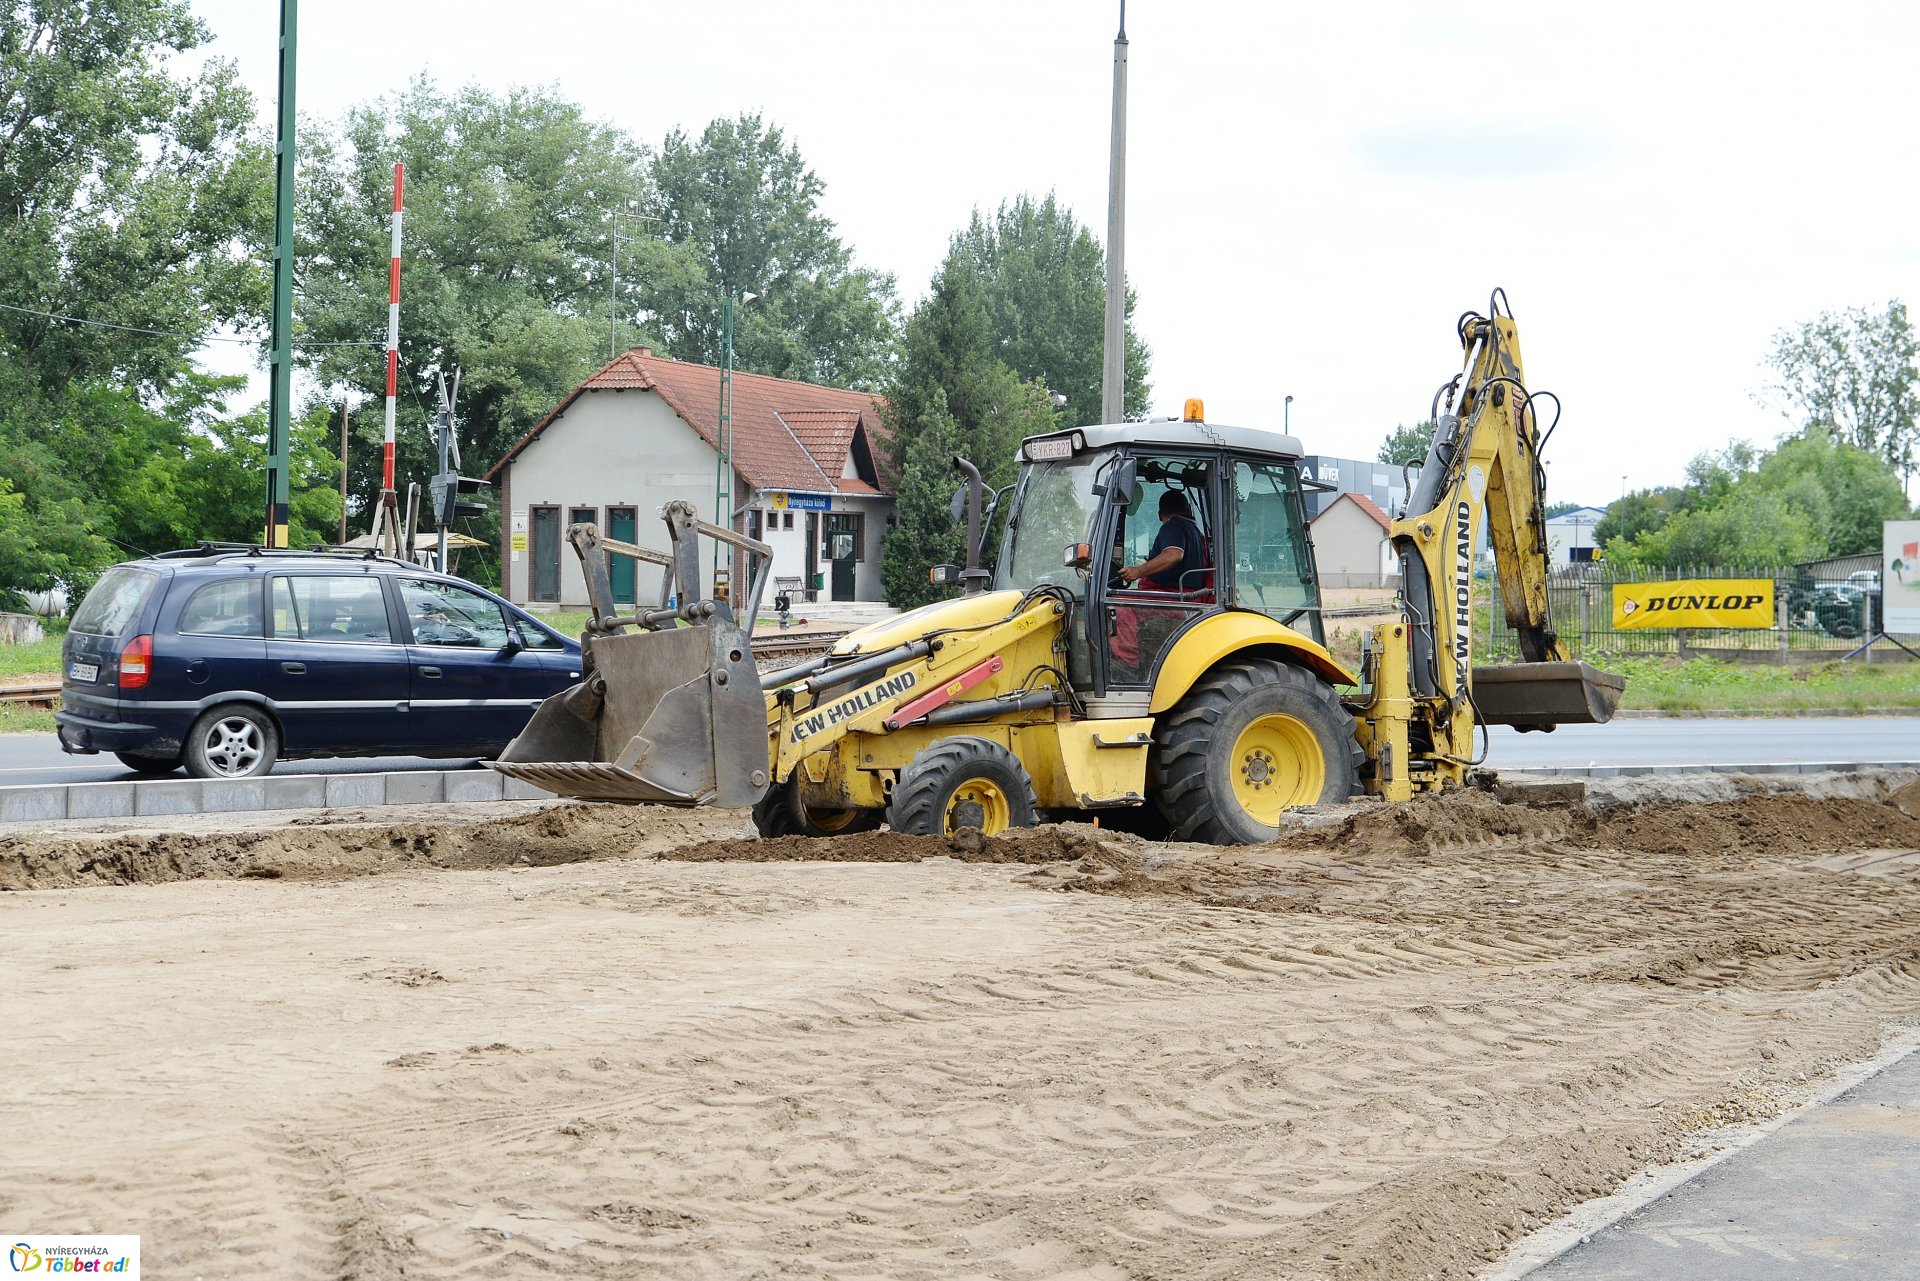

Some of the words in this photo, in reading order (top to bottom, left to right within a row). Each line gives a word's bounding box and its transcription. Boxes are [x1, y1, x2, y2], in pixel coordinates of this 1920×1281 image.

[1456, 501, 1470, 627] HOLLAND
[1645, 595, 1764, 612] DUNLOP
[826, 671, 916, 724] HOLLAND
